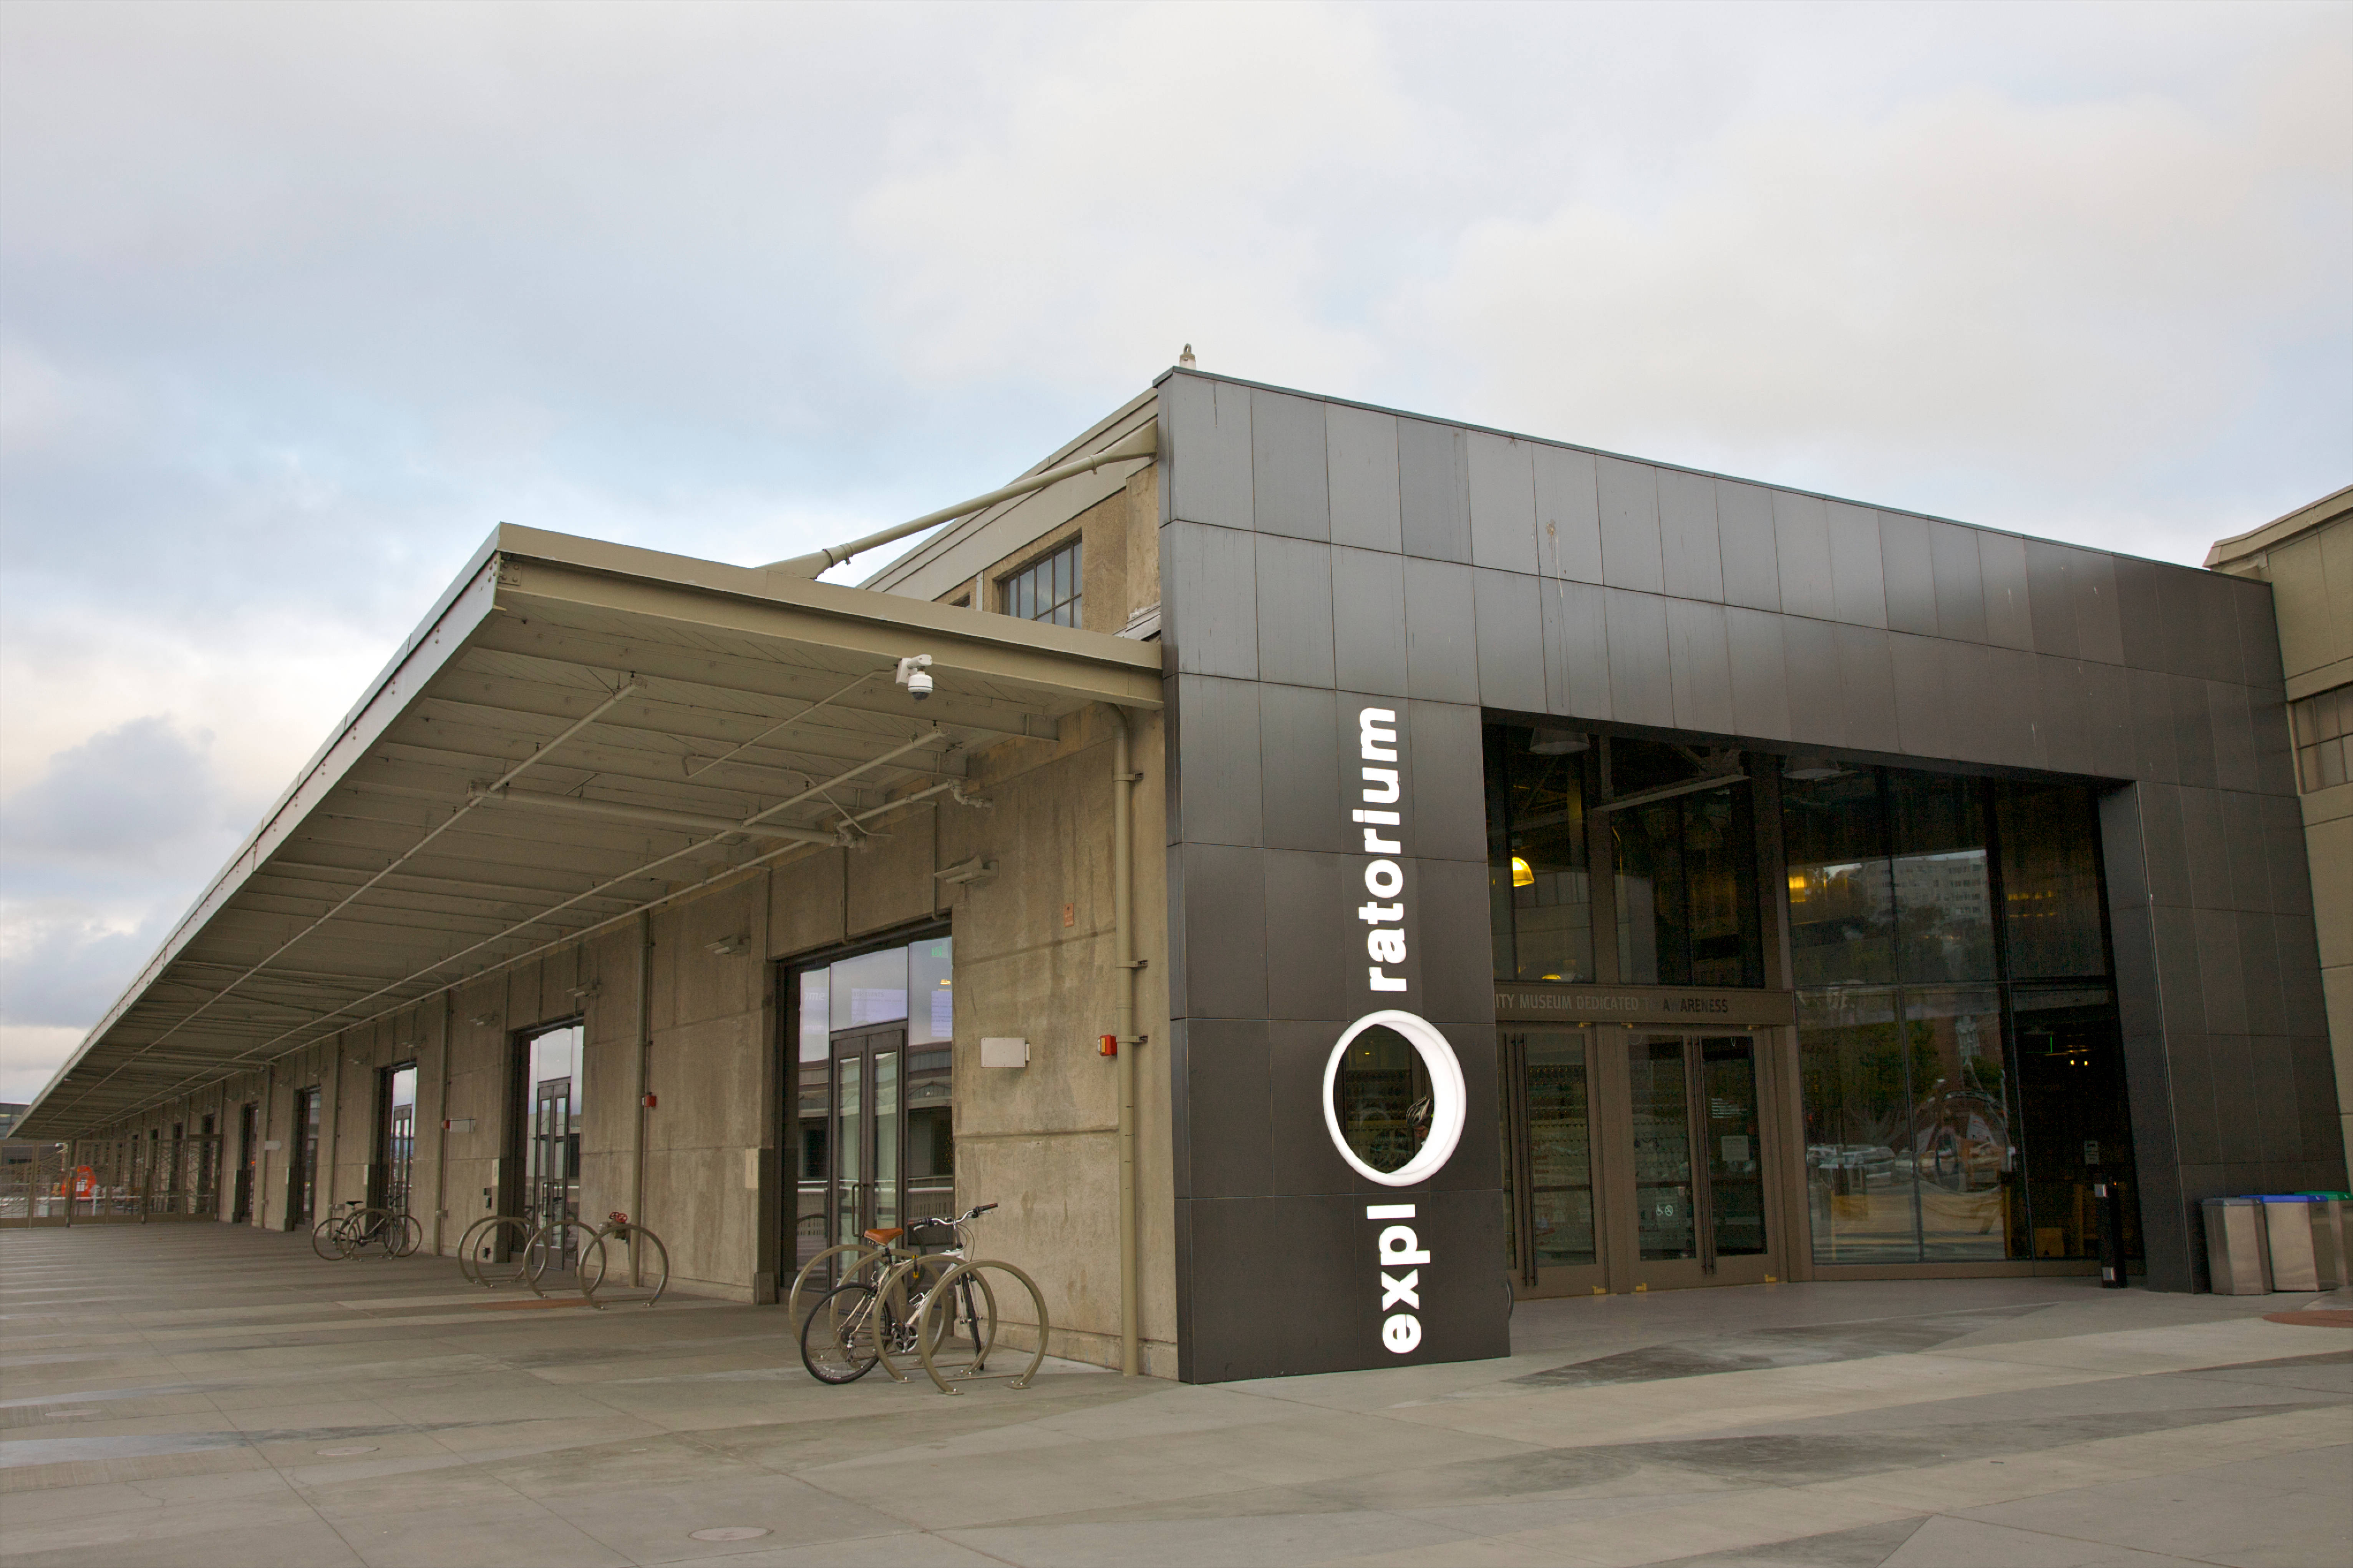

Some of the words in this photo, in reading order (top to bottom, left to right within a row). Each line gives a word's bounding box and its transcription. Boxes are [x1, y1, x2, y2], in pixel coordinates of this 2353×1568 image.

[1520, 994, 1572, 1009] MUSEUM
[1576, 995, 1638, 1011] DEDICATED
[1663, 998, 1728, 1013] AWARENESS
